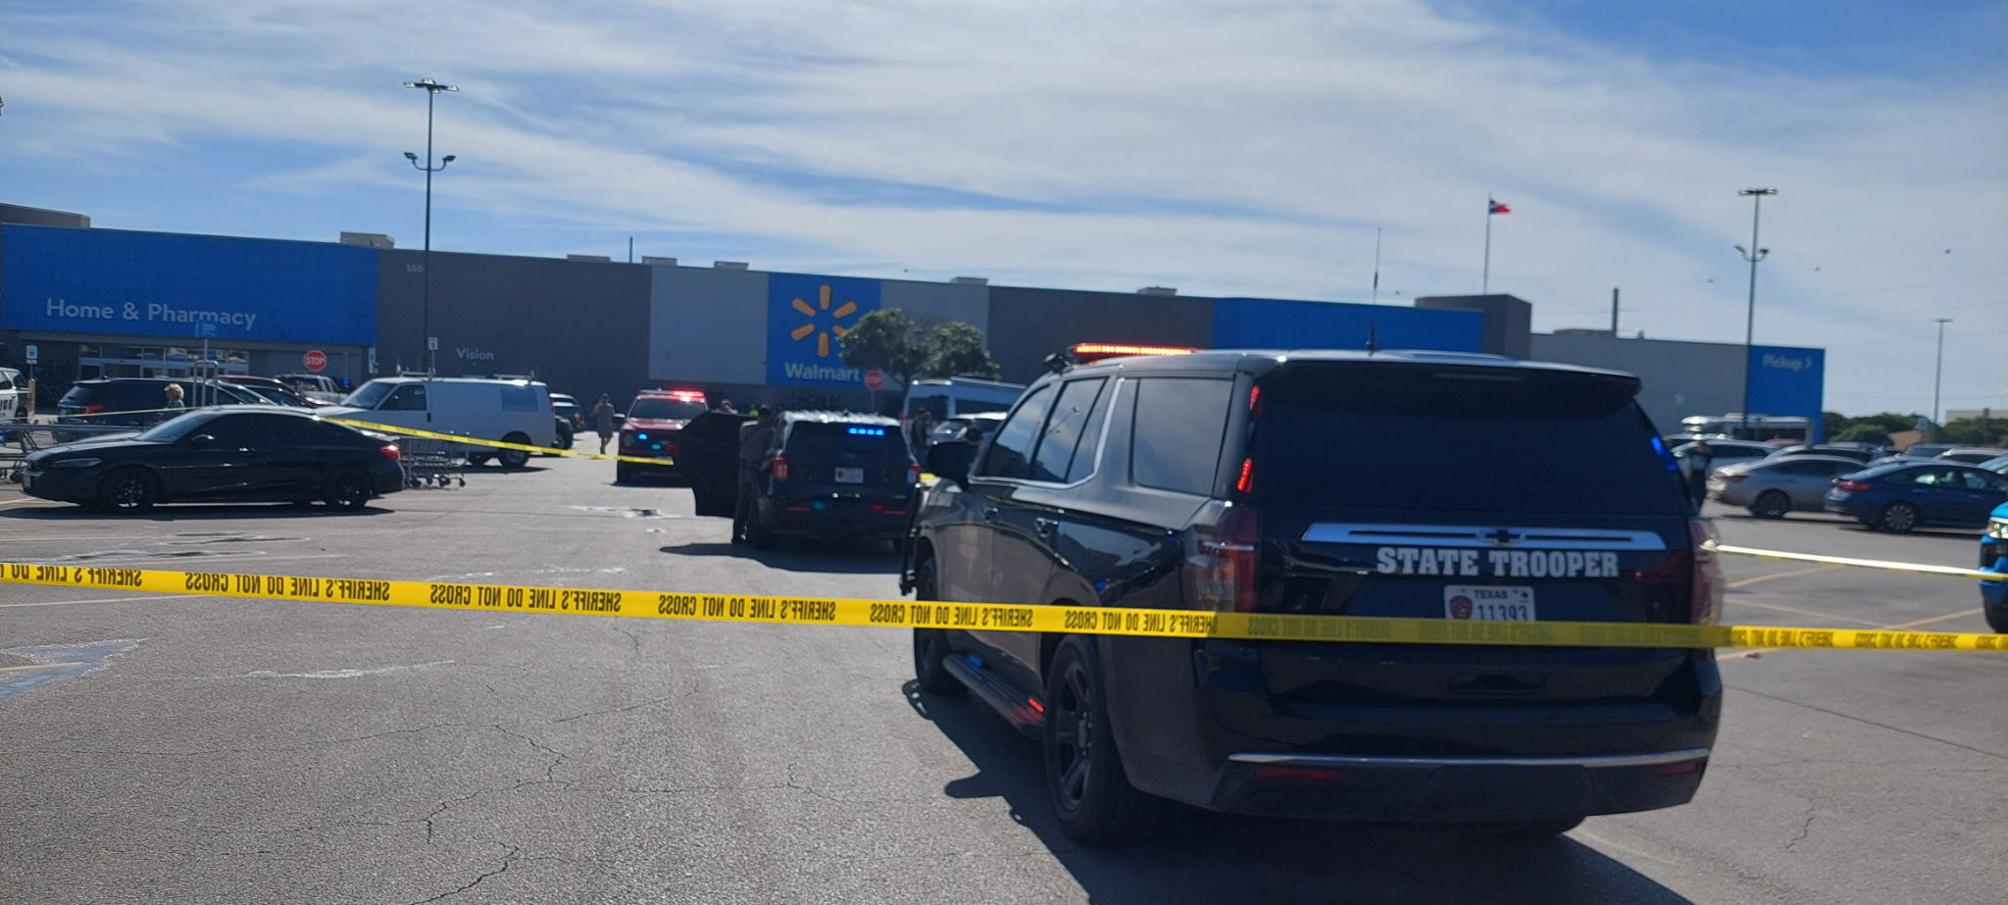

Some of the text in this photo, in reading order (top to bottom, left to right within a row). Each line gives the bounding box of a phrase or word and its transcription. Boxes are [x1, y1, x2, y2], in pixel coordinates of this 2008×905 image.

[46, 298, 257, 331] Home & Pharmacy
[456, 347, 494, 361] Vision
[784, 362, 860, 382] Walmart
[1377, 547, 1619, 578] STATE TROOPER
[1473, 589, 1508, 600] TEXAS
